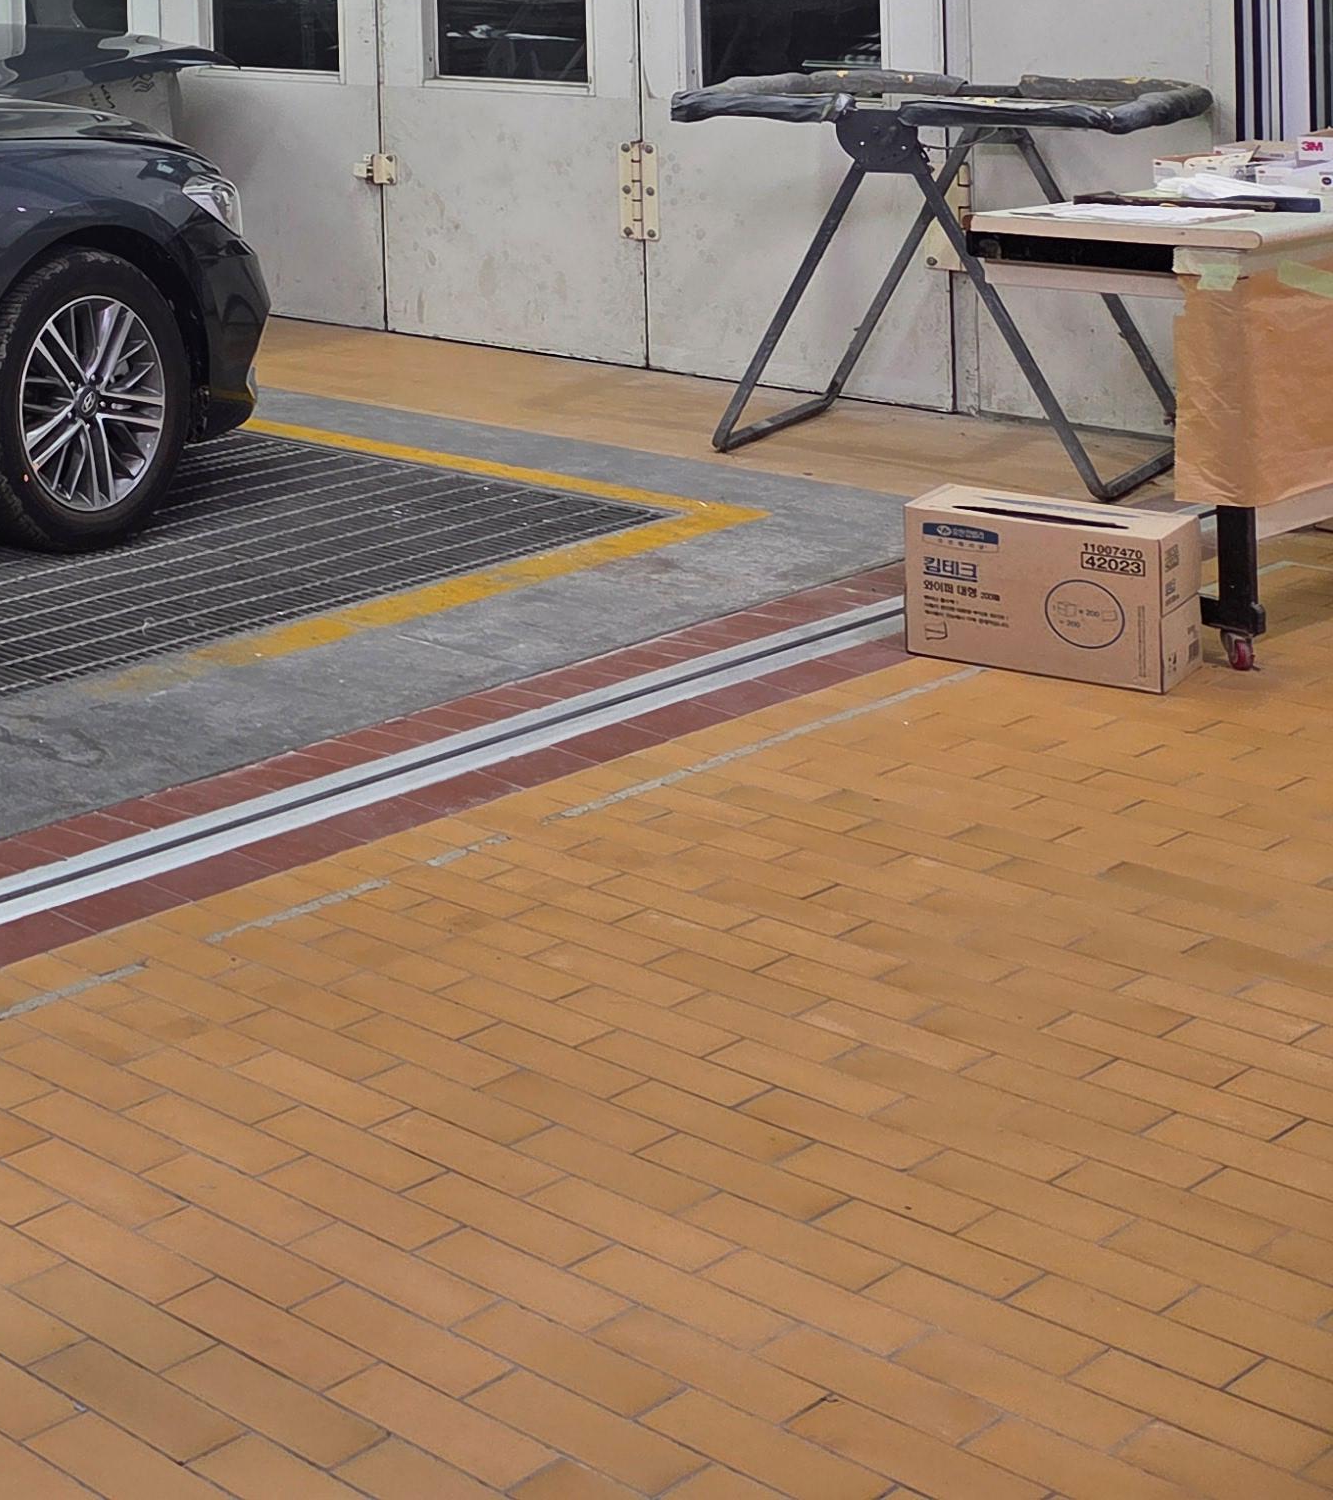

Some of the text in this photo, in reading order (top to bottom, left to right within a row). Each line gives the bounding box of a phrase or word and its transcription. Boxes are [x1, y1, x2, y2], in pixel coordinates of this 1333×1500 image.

[1301, 141, 1323, 152] 3M
[1083, 543, 1143, 559] 11007470
[1085, 556, 1142, 574] 42023
